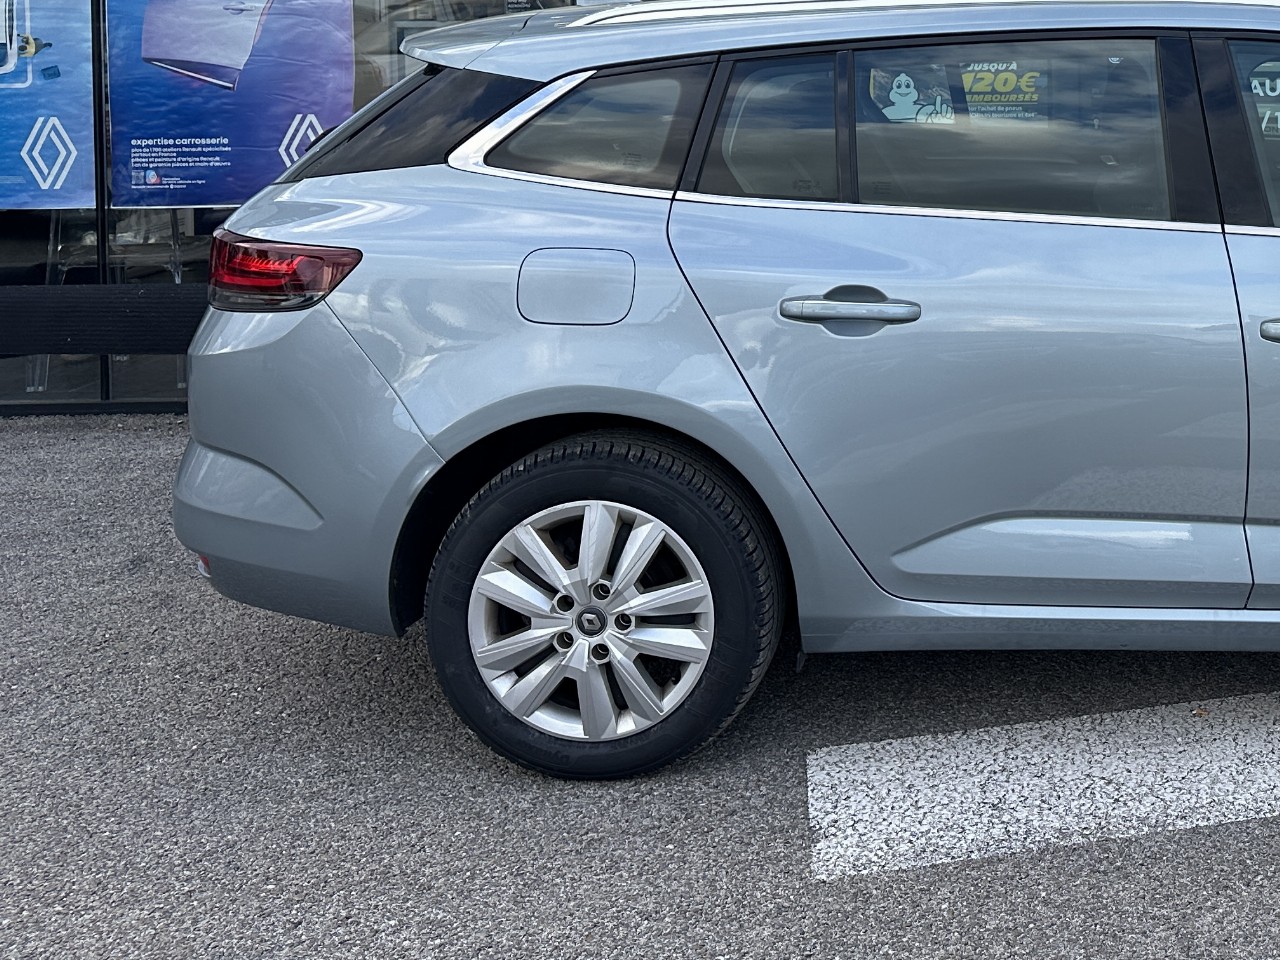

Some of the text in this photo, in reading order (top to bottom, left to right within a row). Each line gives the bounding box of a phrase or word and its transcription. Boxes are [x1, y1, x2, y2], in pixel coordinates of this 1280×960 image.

[967, 61, 1017, 73] JUSQU'À
[961, 71, 1041, 93] 120€
[1251, 79, 1280, 97] AU
[131, 135, 229, 148] expertise carrosserie
